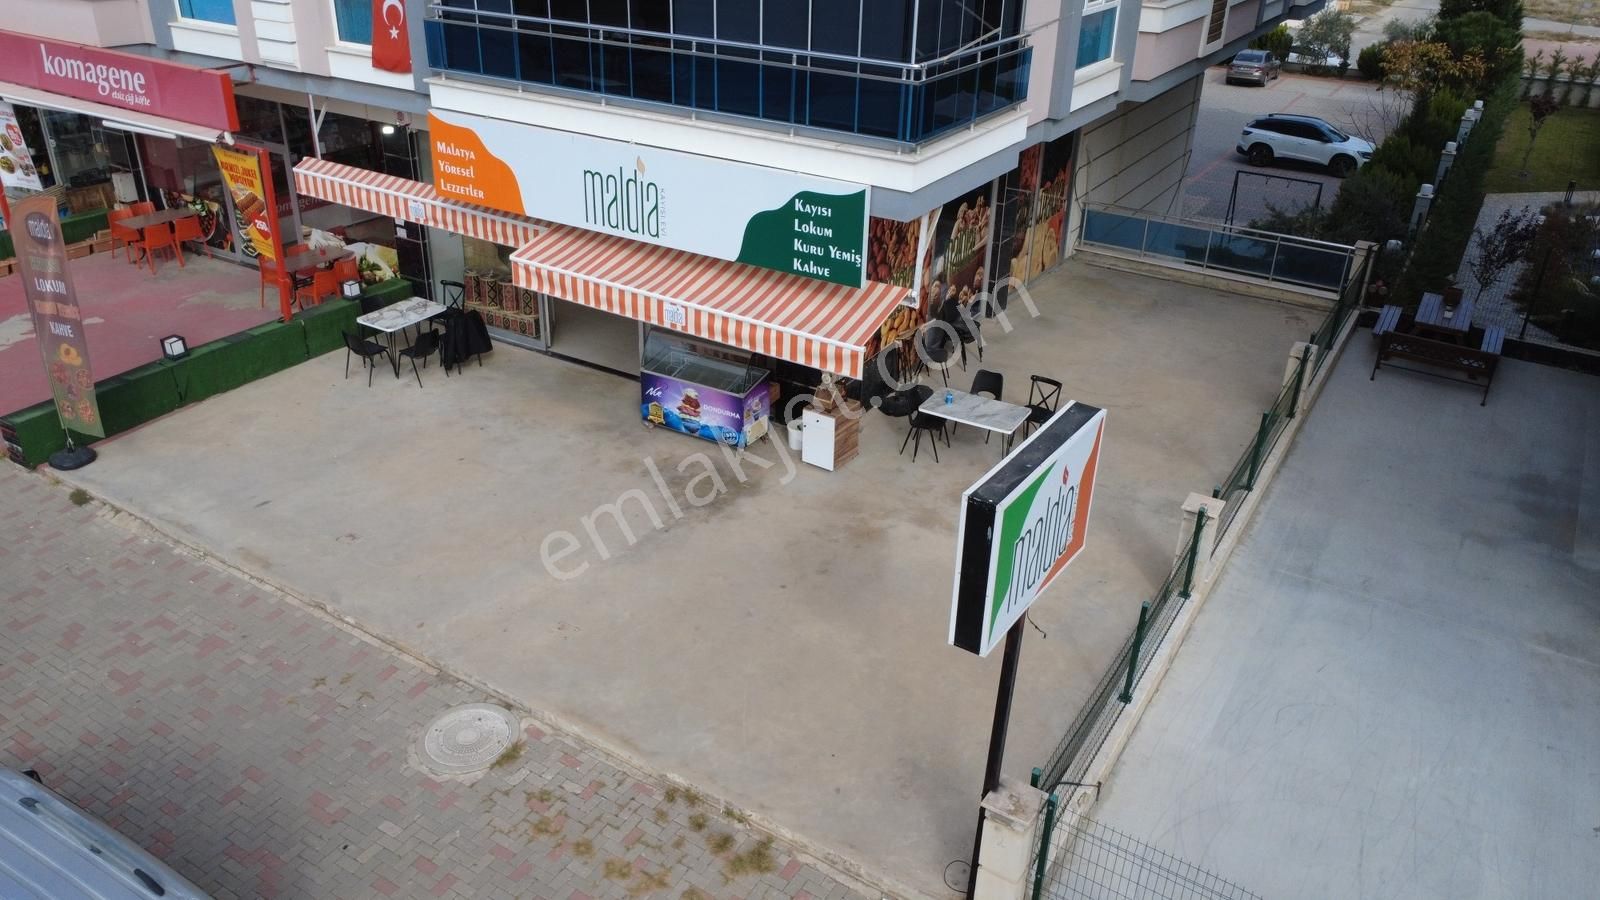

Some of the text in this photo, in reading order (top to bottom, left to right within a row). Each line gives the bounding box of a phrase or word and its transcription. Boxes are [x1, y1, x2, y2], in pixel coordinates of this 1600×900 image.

[40, 44, 146, 96] komagene
[436, 141, 475, 160] MALATYA
[438, 160, 475, 178] YÖRESEL
[441, 178, 485, 199] LEZZETLER
[583, 156, 659, 239] maldia
[794, 199, 832, 217] KAYISI
[794, 218, 833, 238] LOKUM
[794, 238, 862, 267] KURU YEMİŞ
[793, 258, 830, 277] KAHVE
[34, 278, 67, 295] LOKUM
[49, 321, 74, 338] KAHVE
[703, 404, 741, 419] DONDURMA
[1006, 466, 1075, 614] maldia
